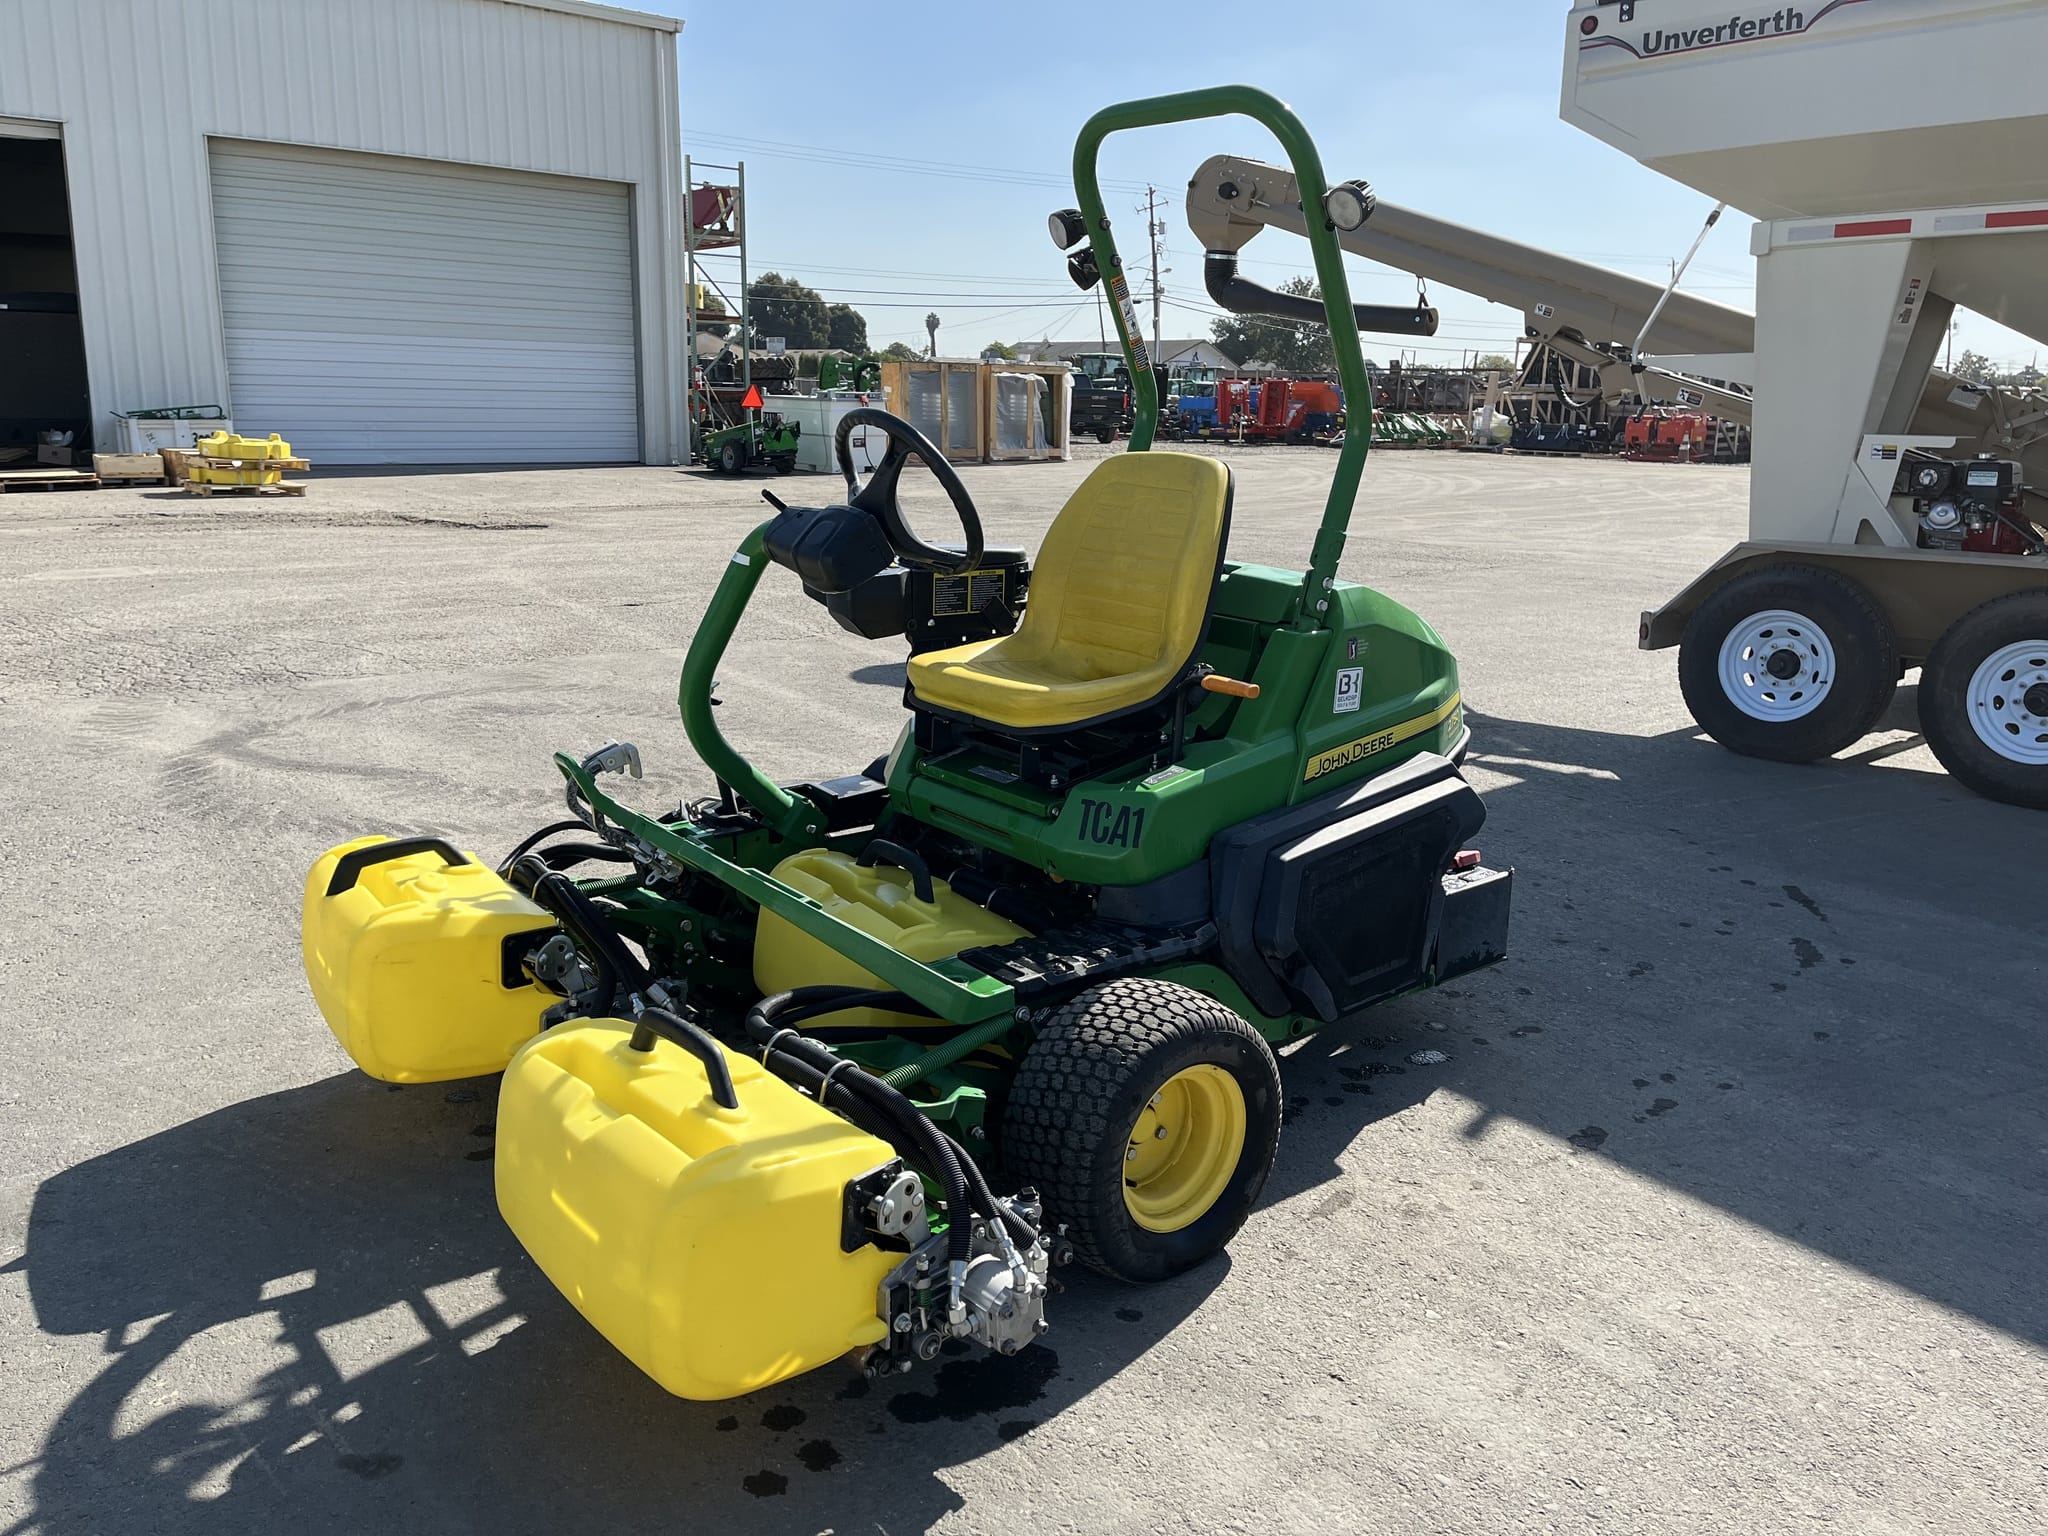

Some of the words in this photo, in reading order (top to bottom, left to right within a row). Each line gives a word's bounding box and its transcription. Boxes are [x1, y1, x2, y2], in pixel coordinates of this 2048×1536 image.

[1643, 7, 1804, 54] Unverferth
[1315, 749, 1350, 775] JOHN
[1353, 731, 1394, 759] DEERE
[1078, 798, 1145, 848] TCA1
